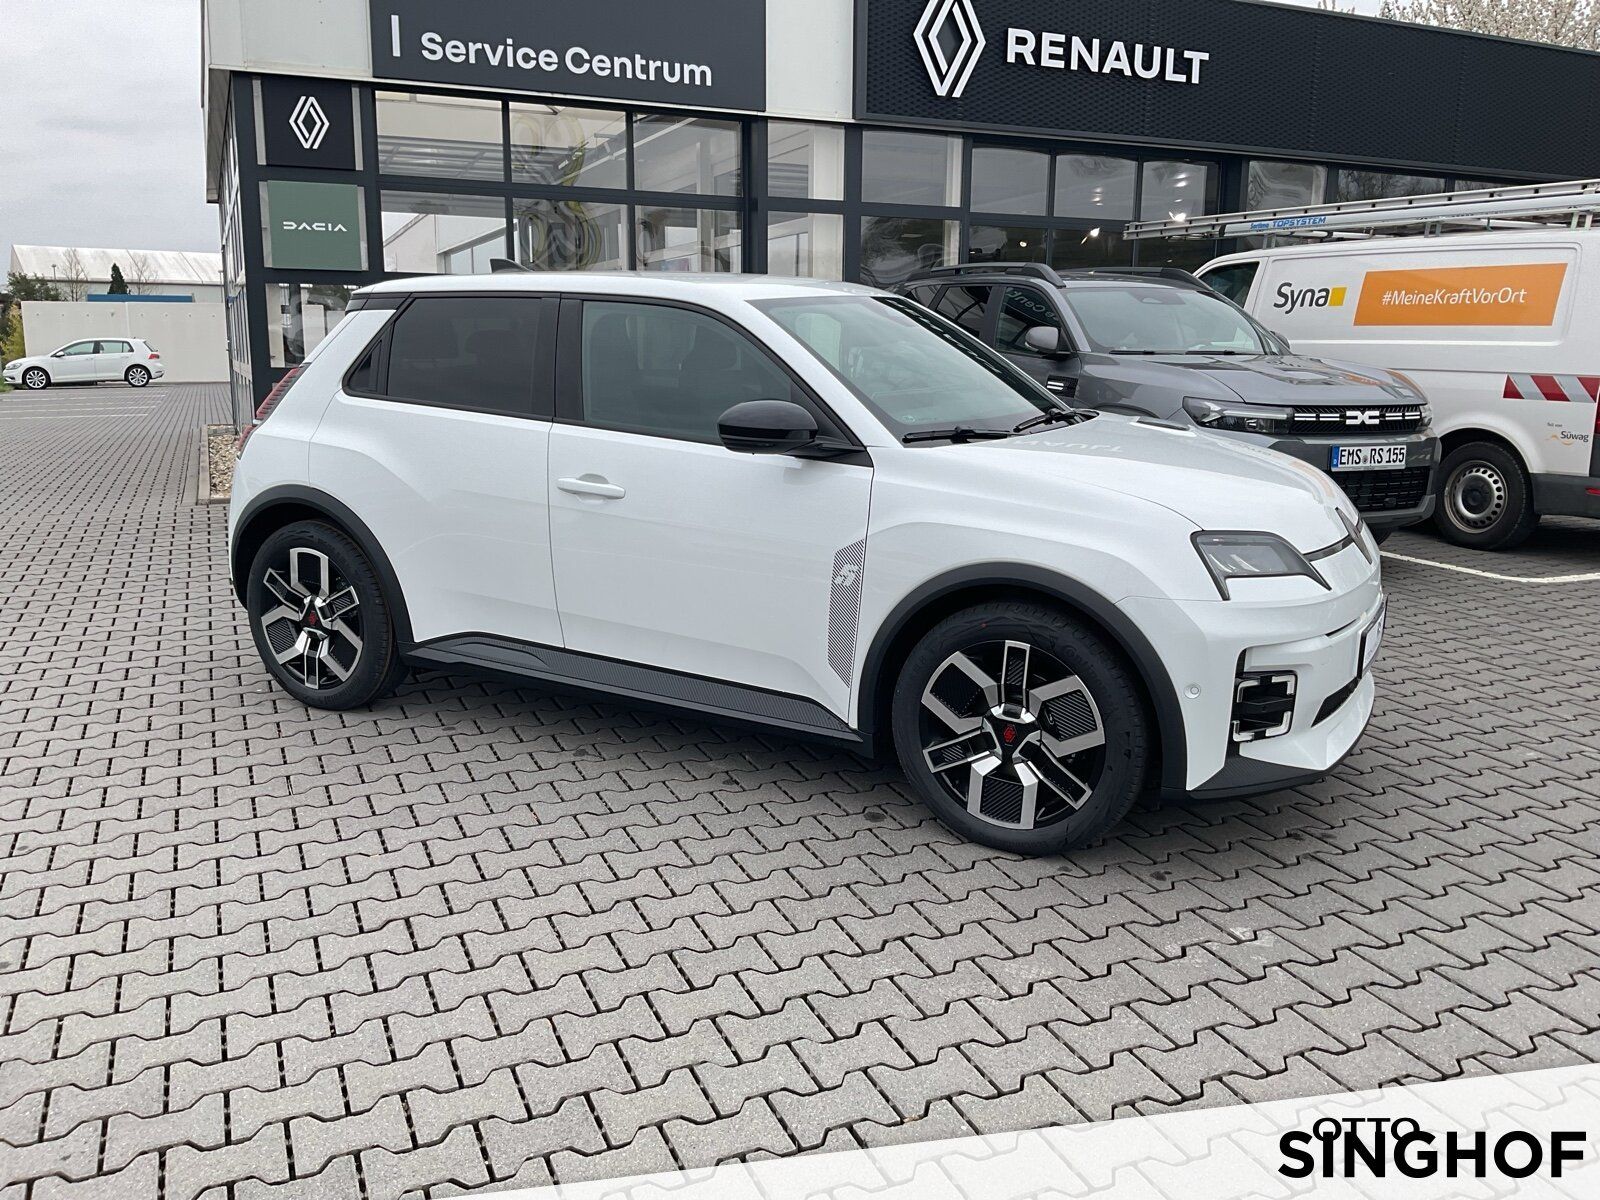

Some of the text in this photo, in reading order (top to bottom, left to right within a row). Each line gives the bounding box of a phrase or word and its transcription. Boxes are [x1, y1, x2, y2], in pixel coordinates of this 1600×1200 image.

[420, 31, 712, 87] Service Centrum
[1006, 27, 1210, 84] RENAULT
[282, 221, 347, 232] DACIA
[1272, 216, 1326, 228] TOPSYSTEM
[1272, 281, 1331, 315] Syna
[1381, 286, 1528, 306] #MeineKraftVorOrt
[1560, 430, 1589, 443] Süwag
[1339, 447, 1405, 465] EMS RS 155
